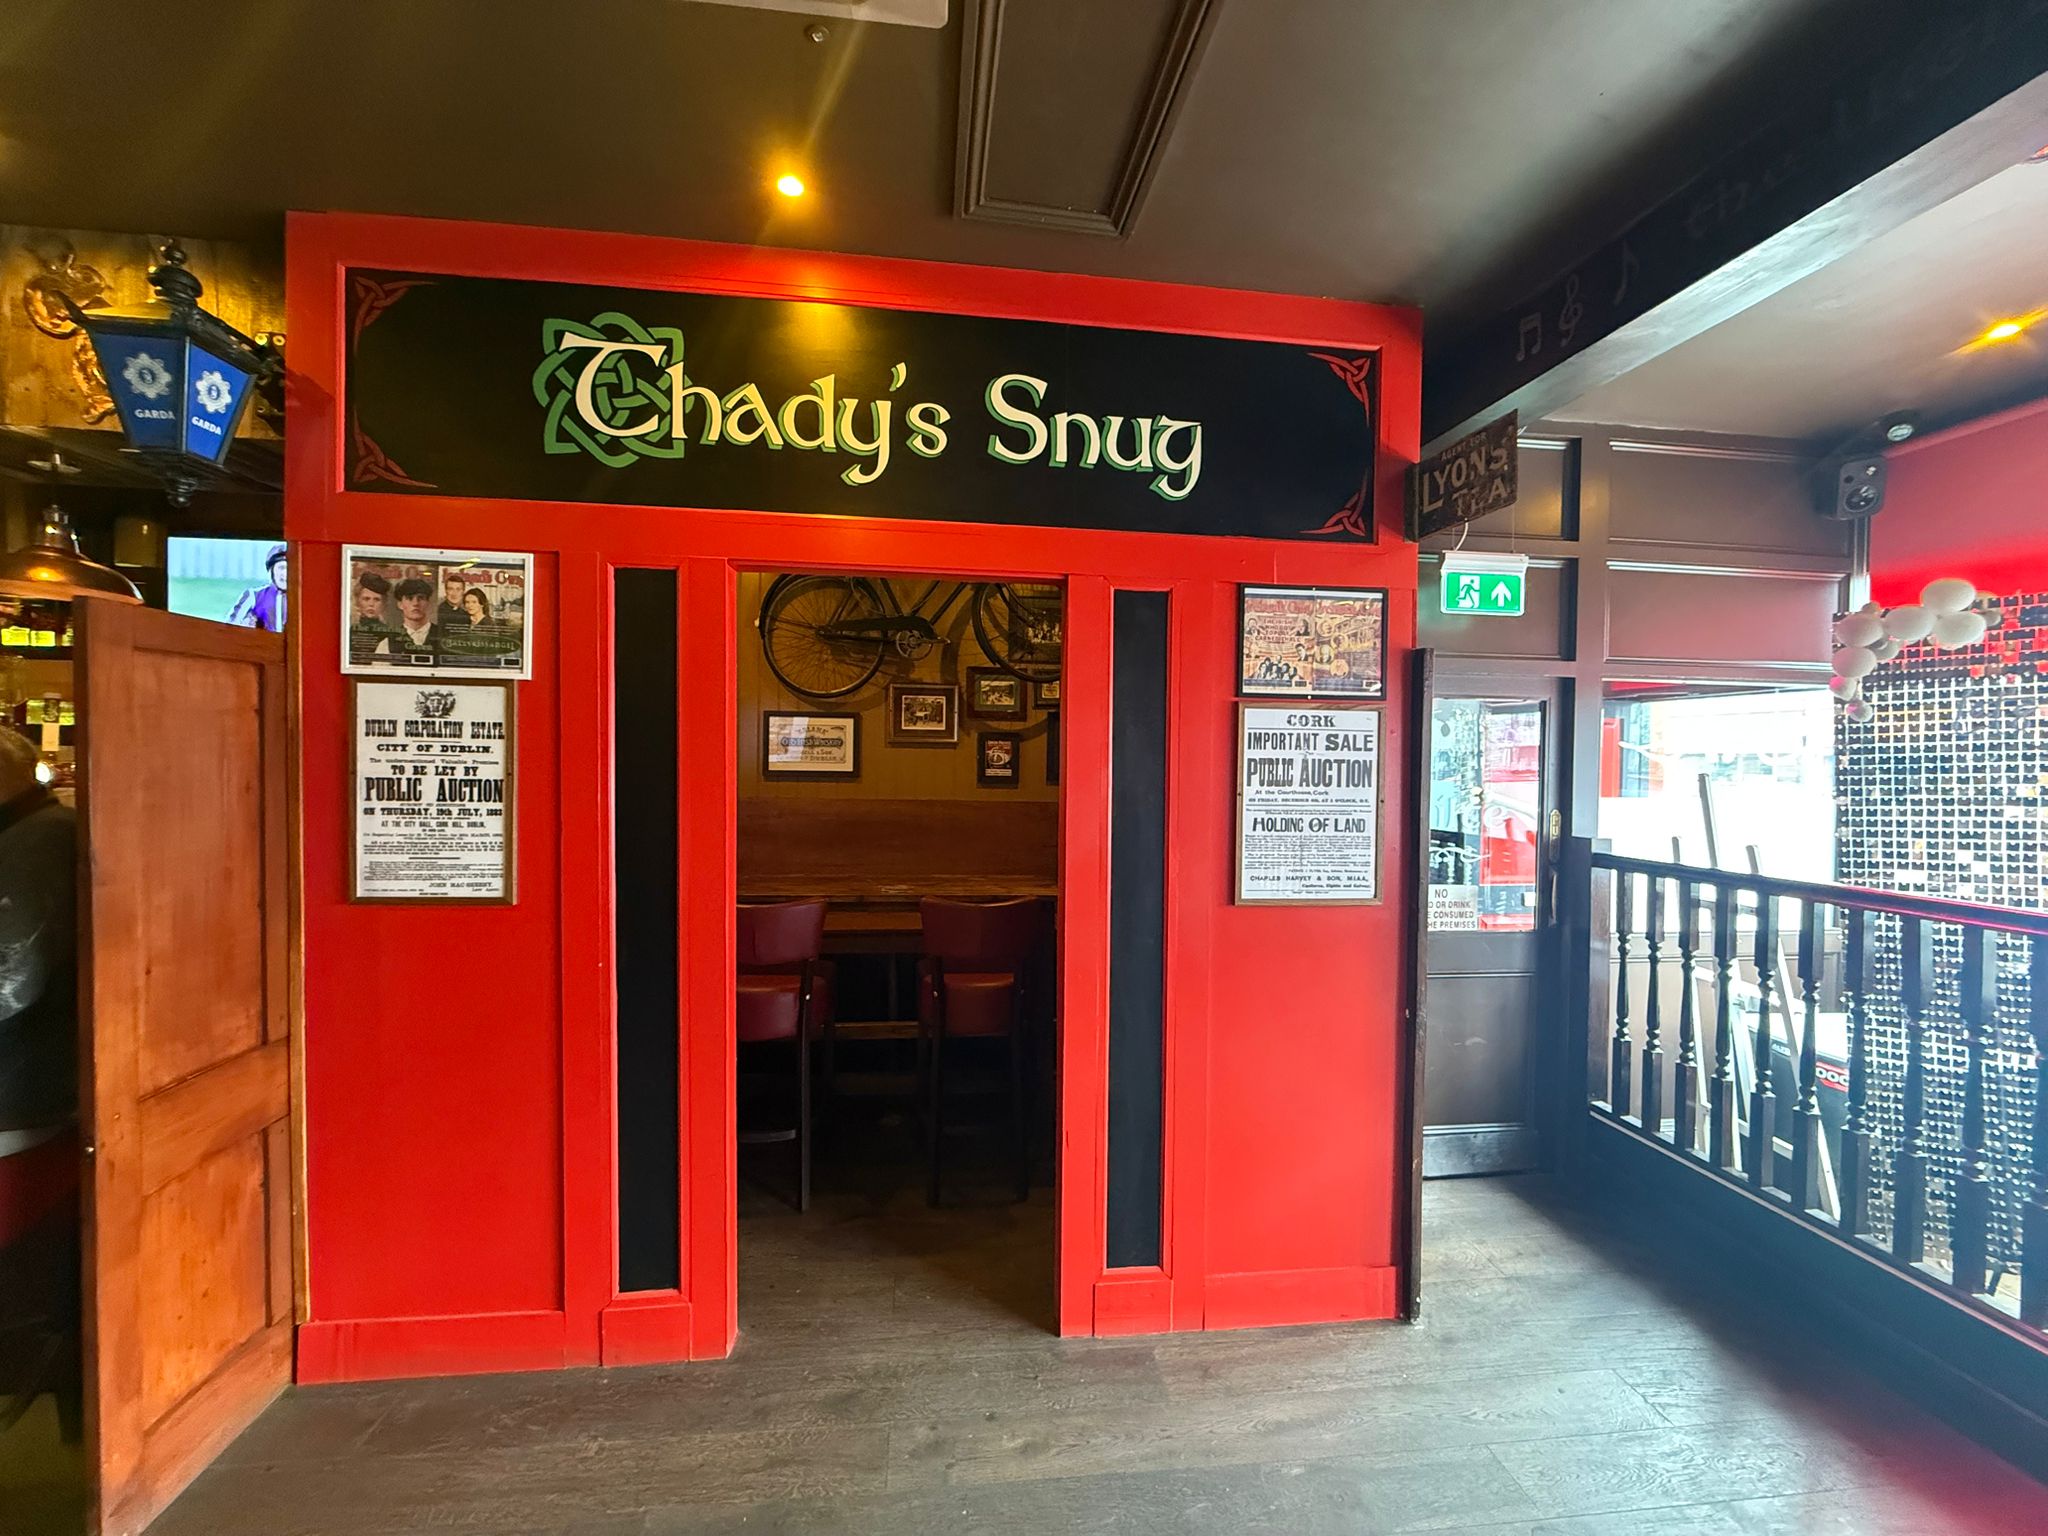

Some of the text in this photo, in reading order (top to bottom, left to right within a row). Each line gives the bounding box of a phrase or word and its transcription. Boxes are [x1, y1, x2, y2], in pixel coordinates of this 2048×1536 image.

[134, 409, 176, 420] GARDA
[560, 332, 1203, 501] Thady's Snug
[191, 416, 222, 435] GARDA
[1452, 477, 1508, 516] TEA
[1286, 714, 1336, 728] CORK
[364, 719, 398, 737] DUBLIN
[404, 720, 464, 739] CORPORATION
[377, 743, 494, 754] CITY OF DUBLIN.
[1247, 731, 1374, 752] IMPORTANT SALE
[391, 765, 479, 777] TO BE LET BY
[1246, 757, 1373, 788] PUBLIC AUCTION
[364, 777, 505, 803] PUBLIC AUCTION
[363, 807, 376, 816] ON
[380, 807, 433, 817] THURSDAY,
[457, 808, 483, 817] JULY,
[1252, 817, 1366, 833] HOLDING OF LAND
[1434, 888, 1448, 898] NO
[1433, 911, 1474, 919] CONSUMED
[1440, 921, 1476, 929] PREMISES
